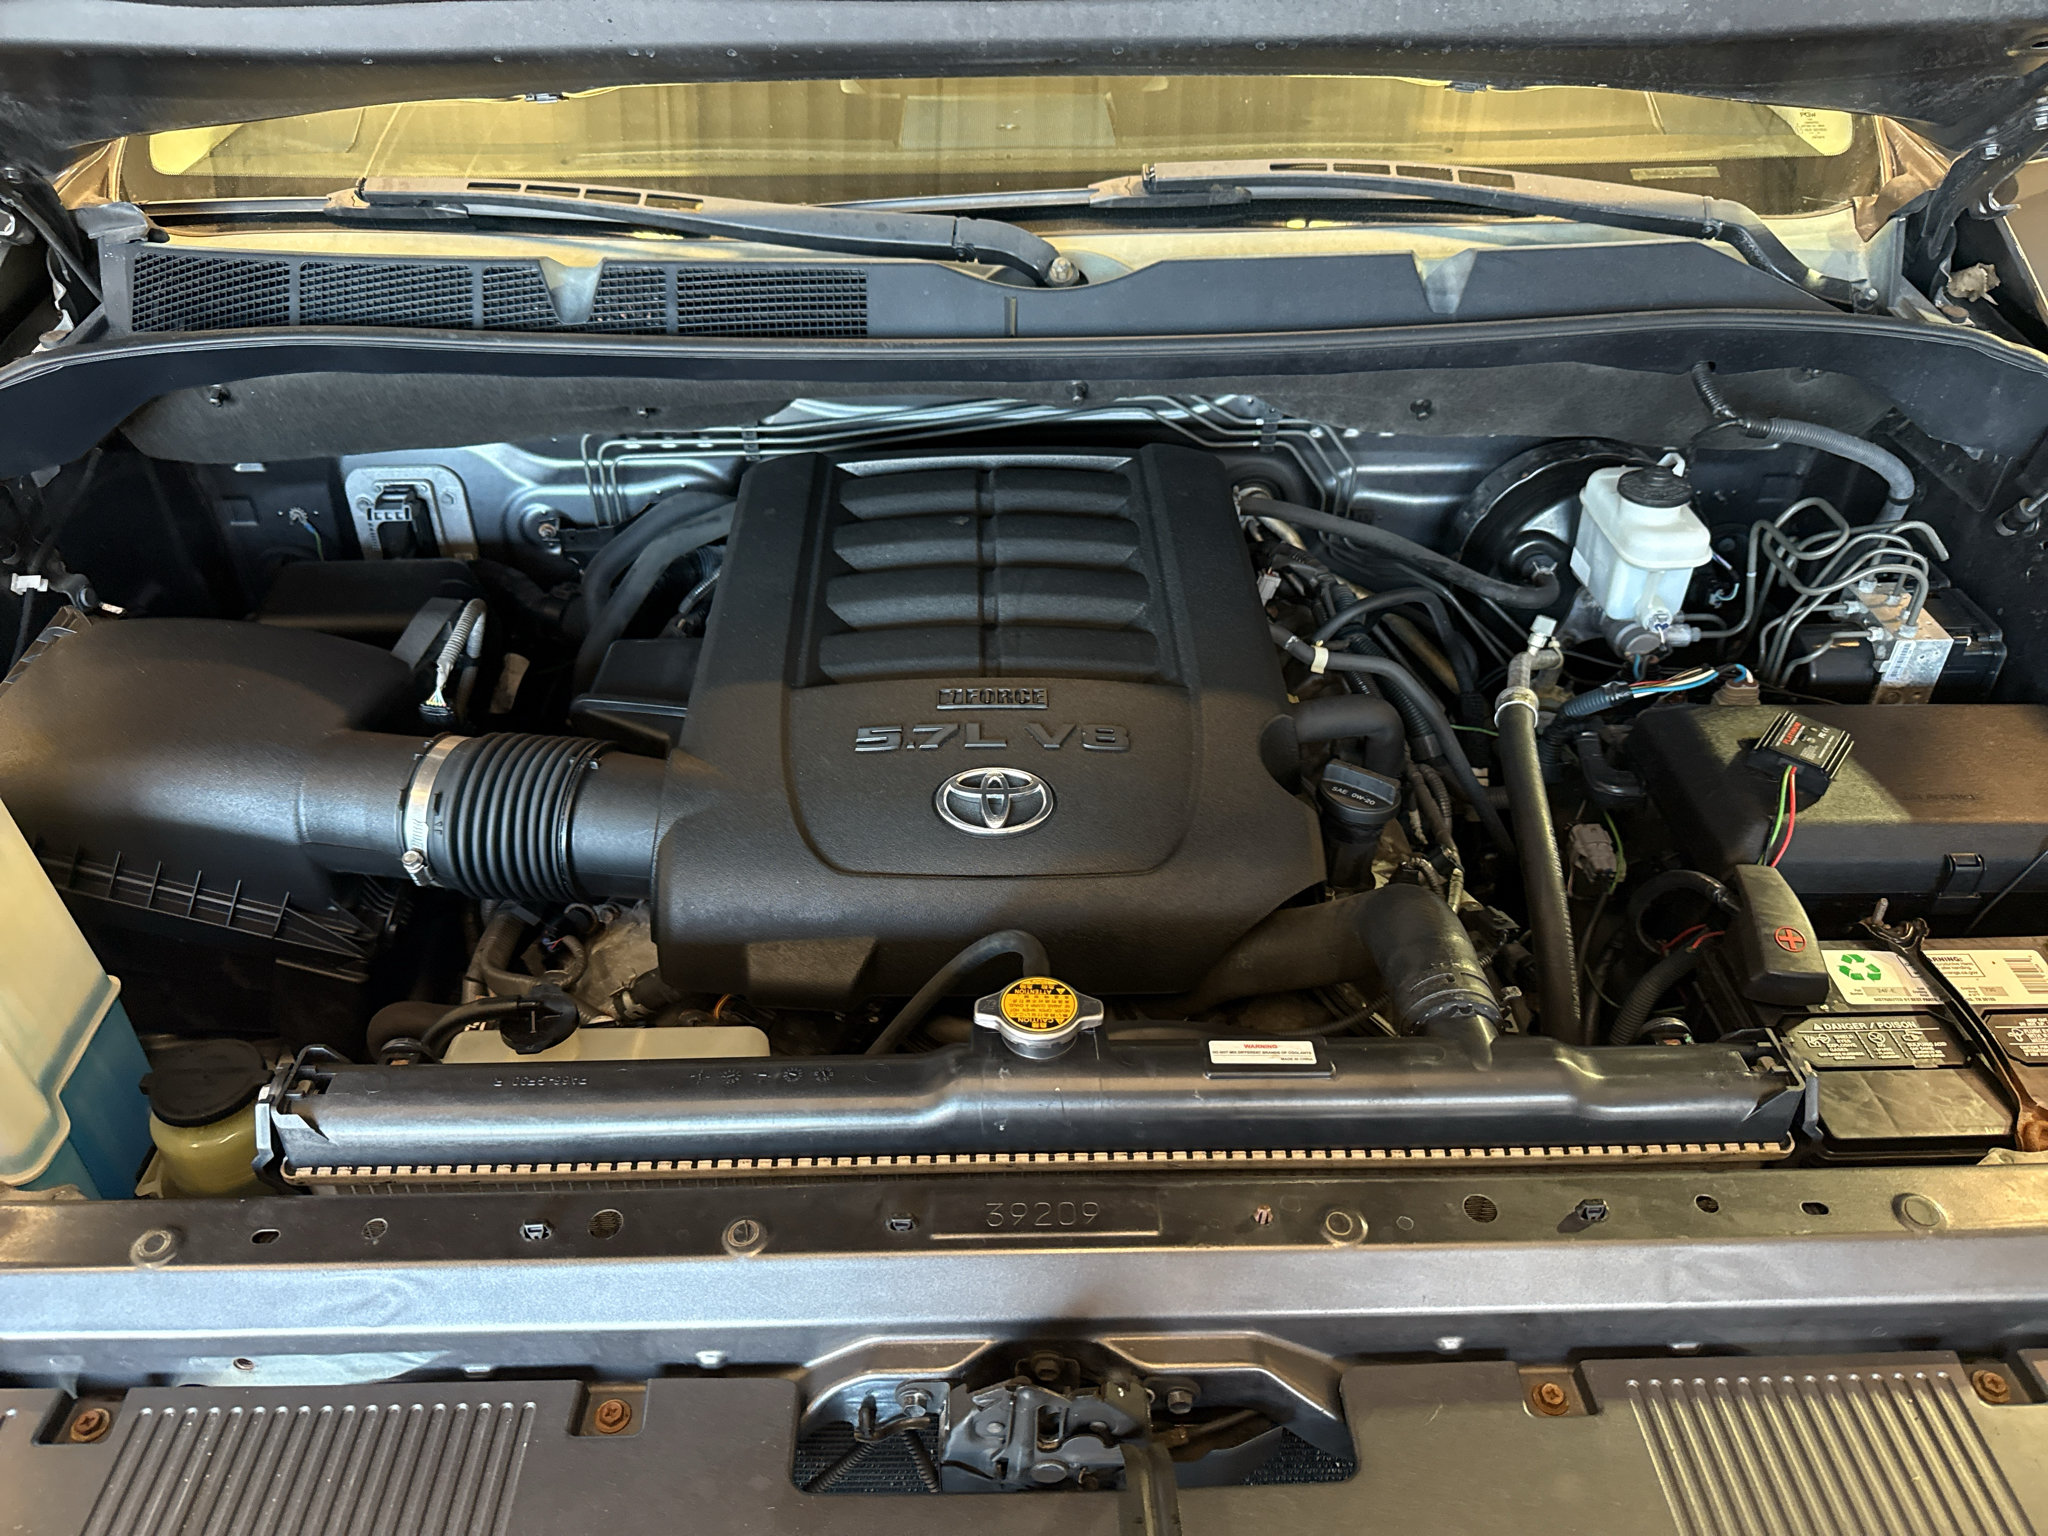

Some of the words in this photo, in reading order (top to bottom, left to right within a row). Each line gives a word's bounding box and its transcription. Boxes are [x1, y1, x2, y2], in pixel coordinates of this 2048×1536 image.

[855, 723, 1007, 752] 5.7L
[1024, 723, 1131, 751] V8
[1331, 786, 1349, 795] SAE
[1351, 792, 1376, 806] 0W-20
[1822, 1022, 1868, 1030] DANGER
[1876, 1021, 1917, 1029] POISON
[985, 1201, 1099, 1227] 39209
